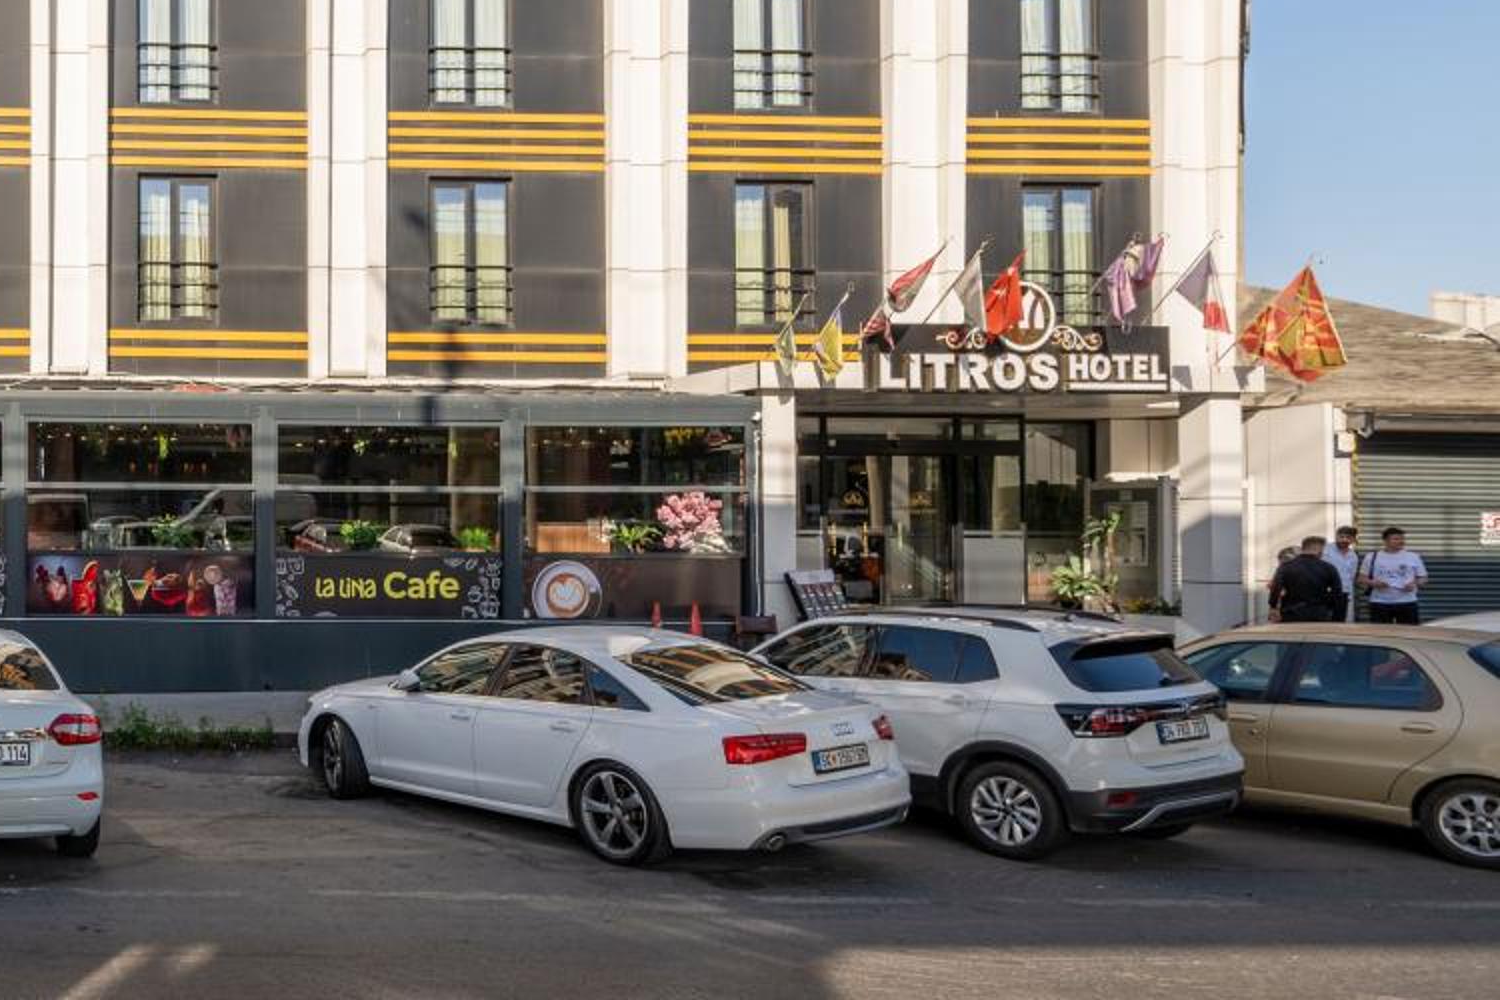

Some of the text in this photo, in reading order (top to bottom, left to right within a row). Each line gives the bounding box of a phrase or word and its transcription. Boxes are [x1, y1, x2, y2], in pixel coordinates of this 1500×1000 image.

[1069, 354, 1167, 381] HOTEL
[383, 570, 461, 599] Cafe
[7, 745, 27, 760] 114
